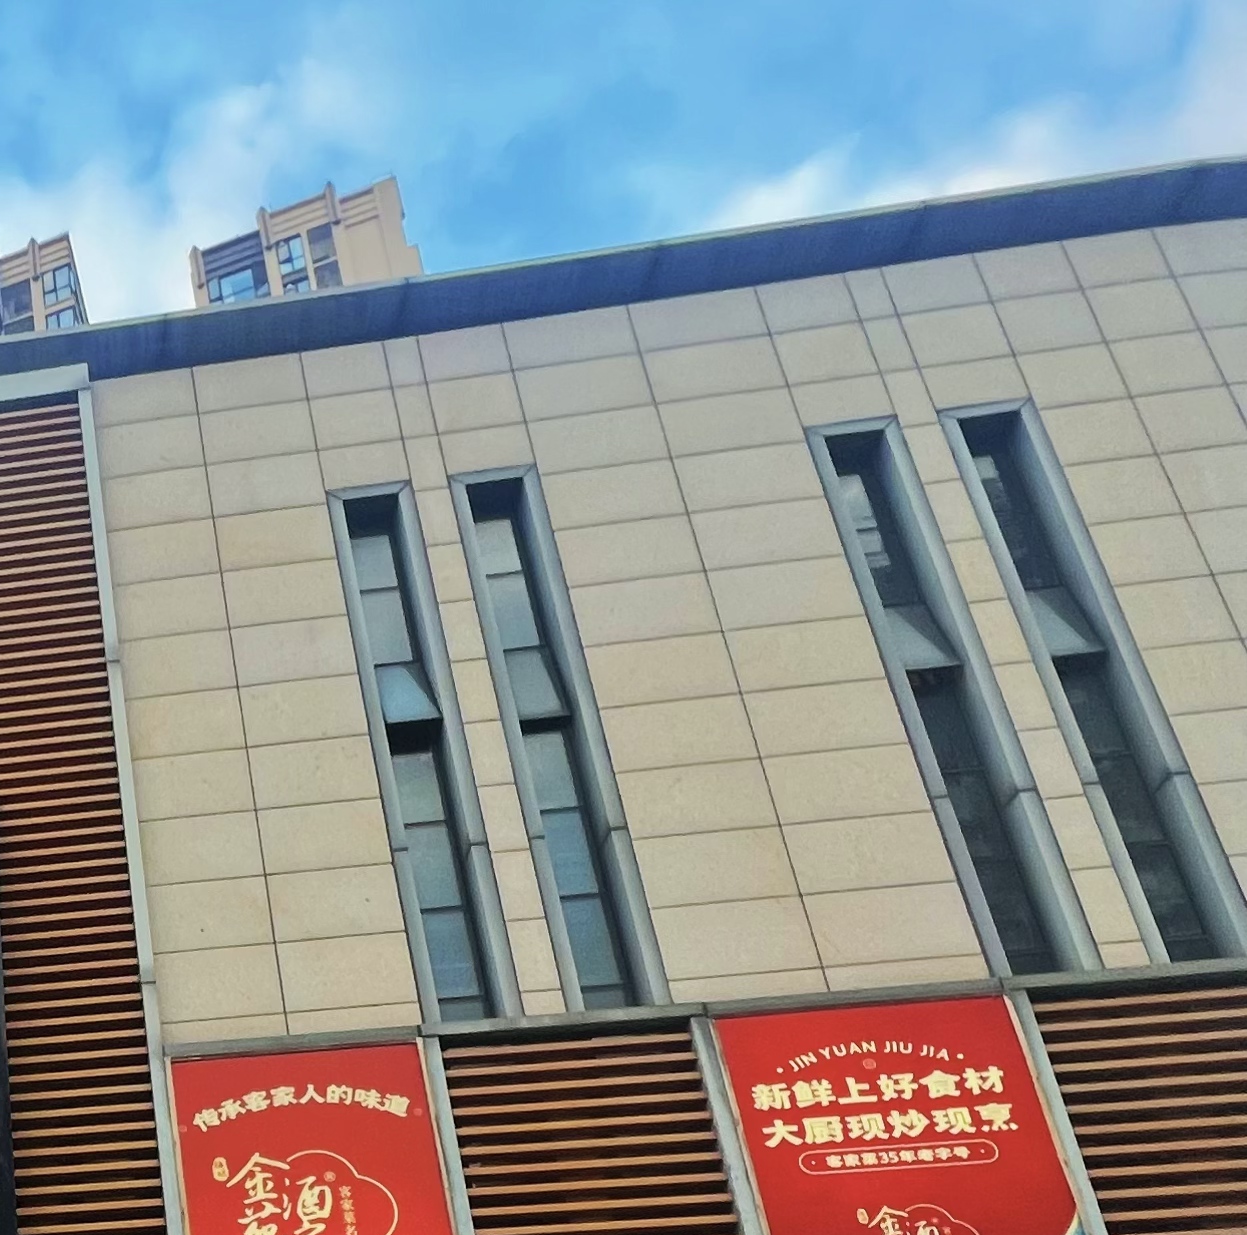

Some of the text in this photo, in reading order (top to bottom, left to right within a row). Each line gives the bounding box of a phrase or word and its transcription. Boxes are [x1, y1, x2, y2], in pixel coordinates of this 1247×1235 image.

[788, 1039, 950, 1073] JIN YUAN JIU JIA
[193, 1084, 411, 1132] 传承客家人的味道
[752, 1065, 1005, 1111] 新鲜上好食材
[762, 1102, 1019, 1148] 大厨现炒现烹
